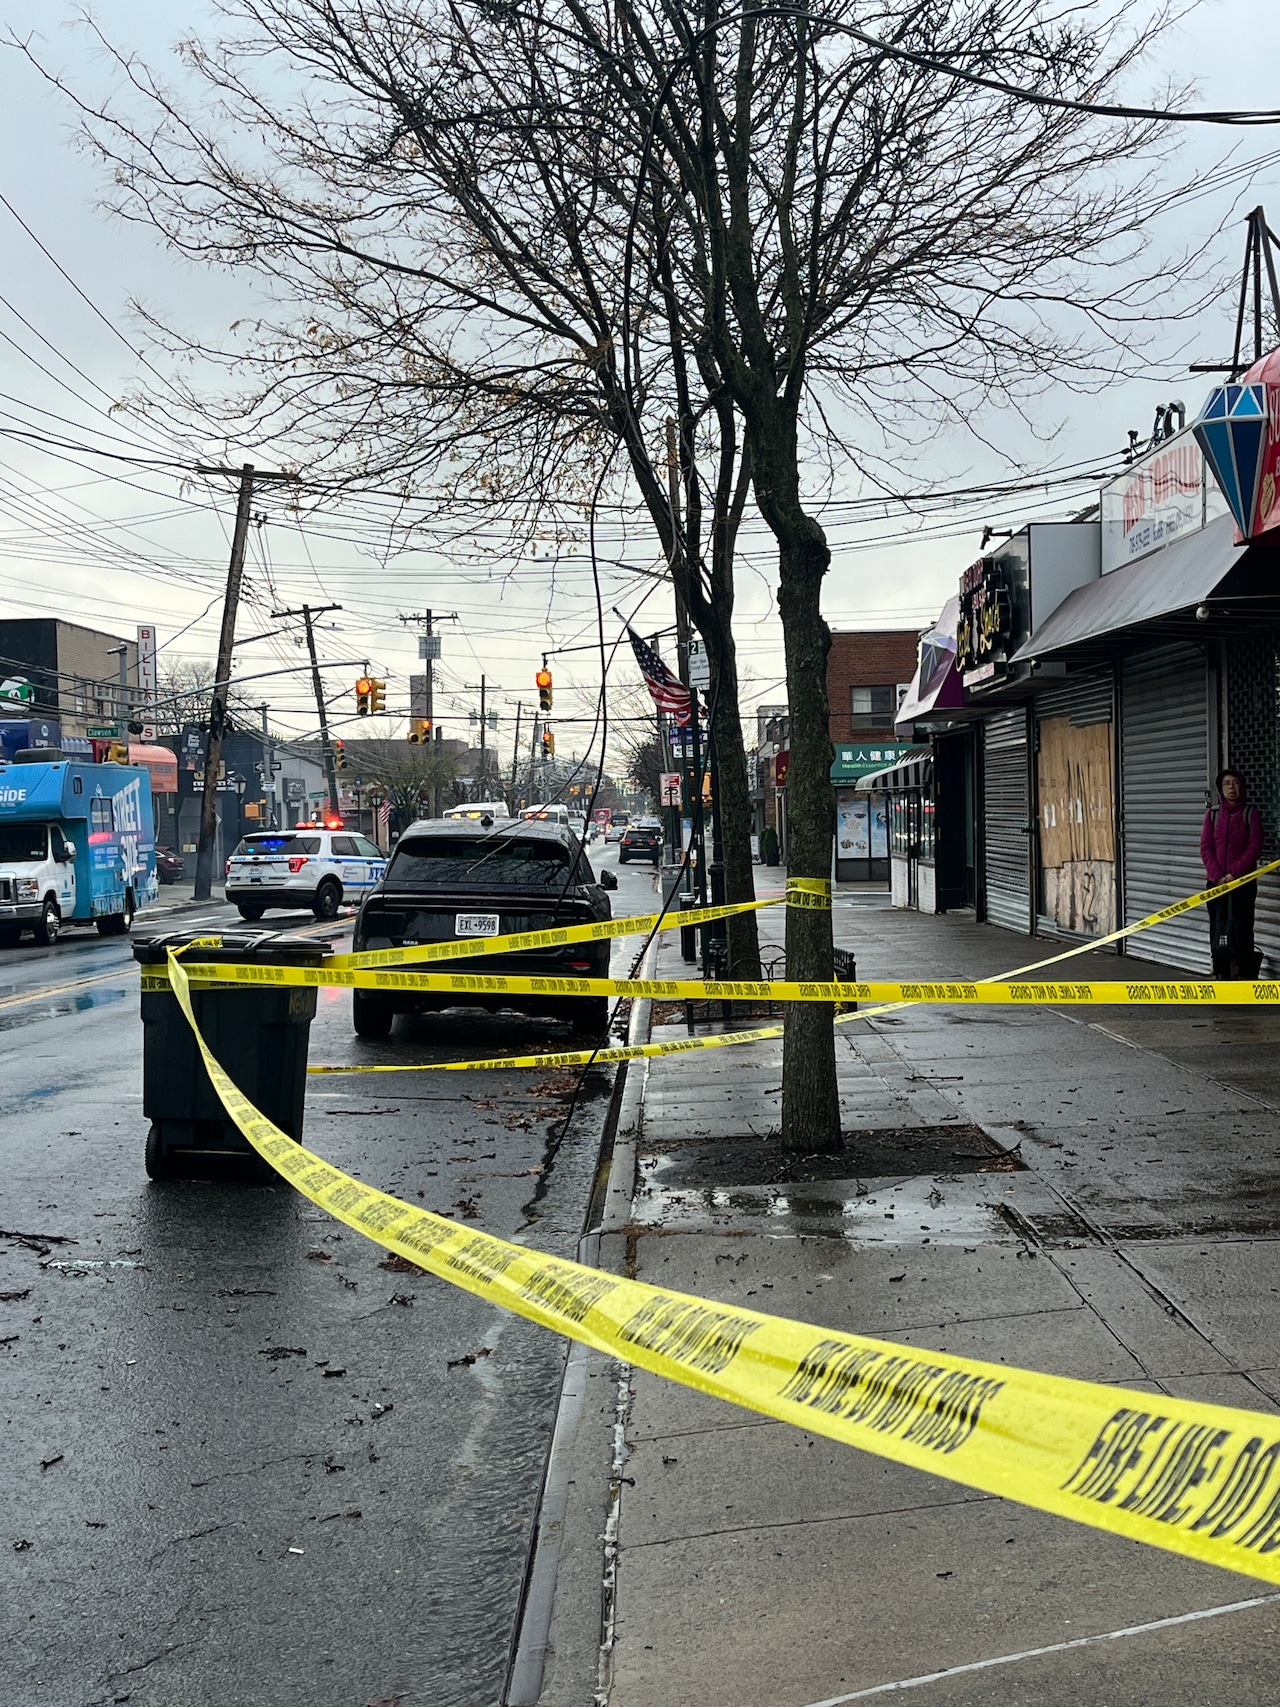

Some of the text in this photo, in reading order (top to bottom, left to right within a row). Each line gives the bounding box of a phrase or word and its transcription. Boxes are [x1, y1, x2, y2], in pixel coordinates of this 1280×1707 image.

[141, 630, 153, 738] BILLIAS
[842, 750, 907, 762] 華人健康
[478, 920, 495, 930] 9598
[777, 1340, 851, 1403] FIRE
[844, 1357, 910, 1423] DO
[902, 1371, 1007, 1454] CROSS
[1059, 1408, 1168, 1503] FIRE
